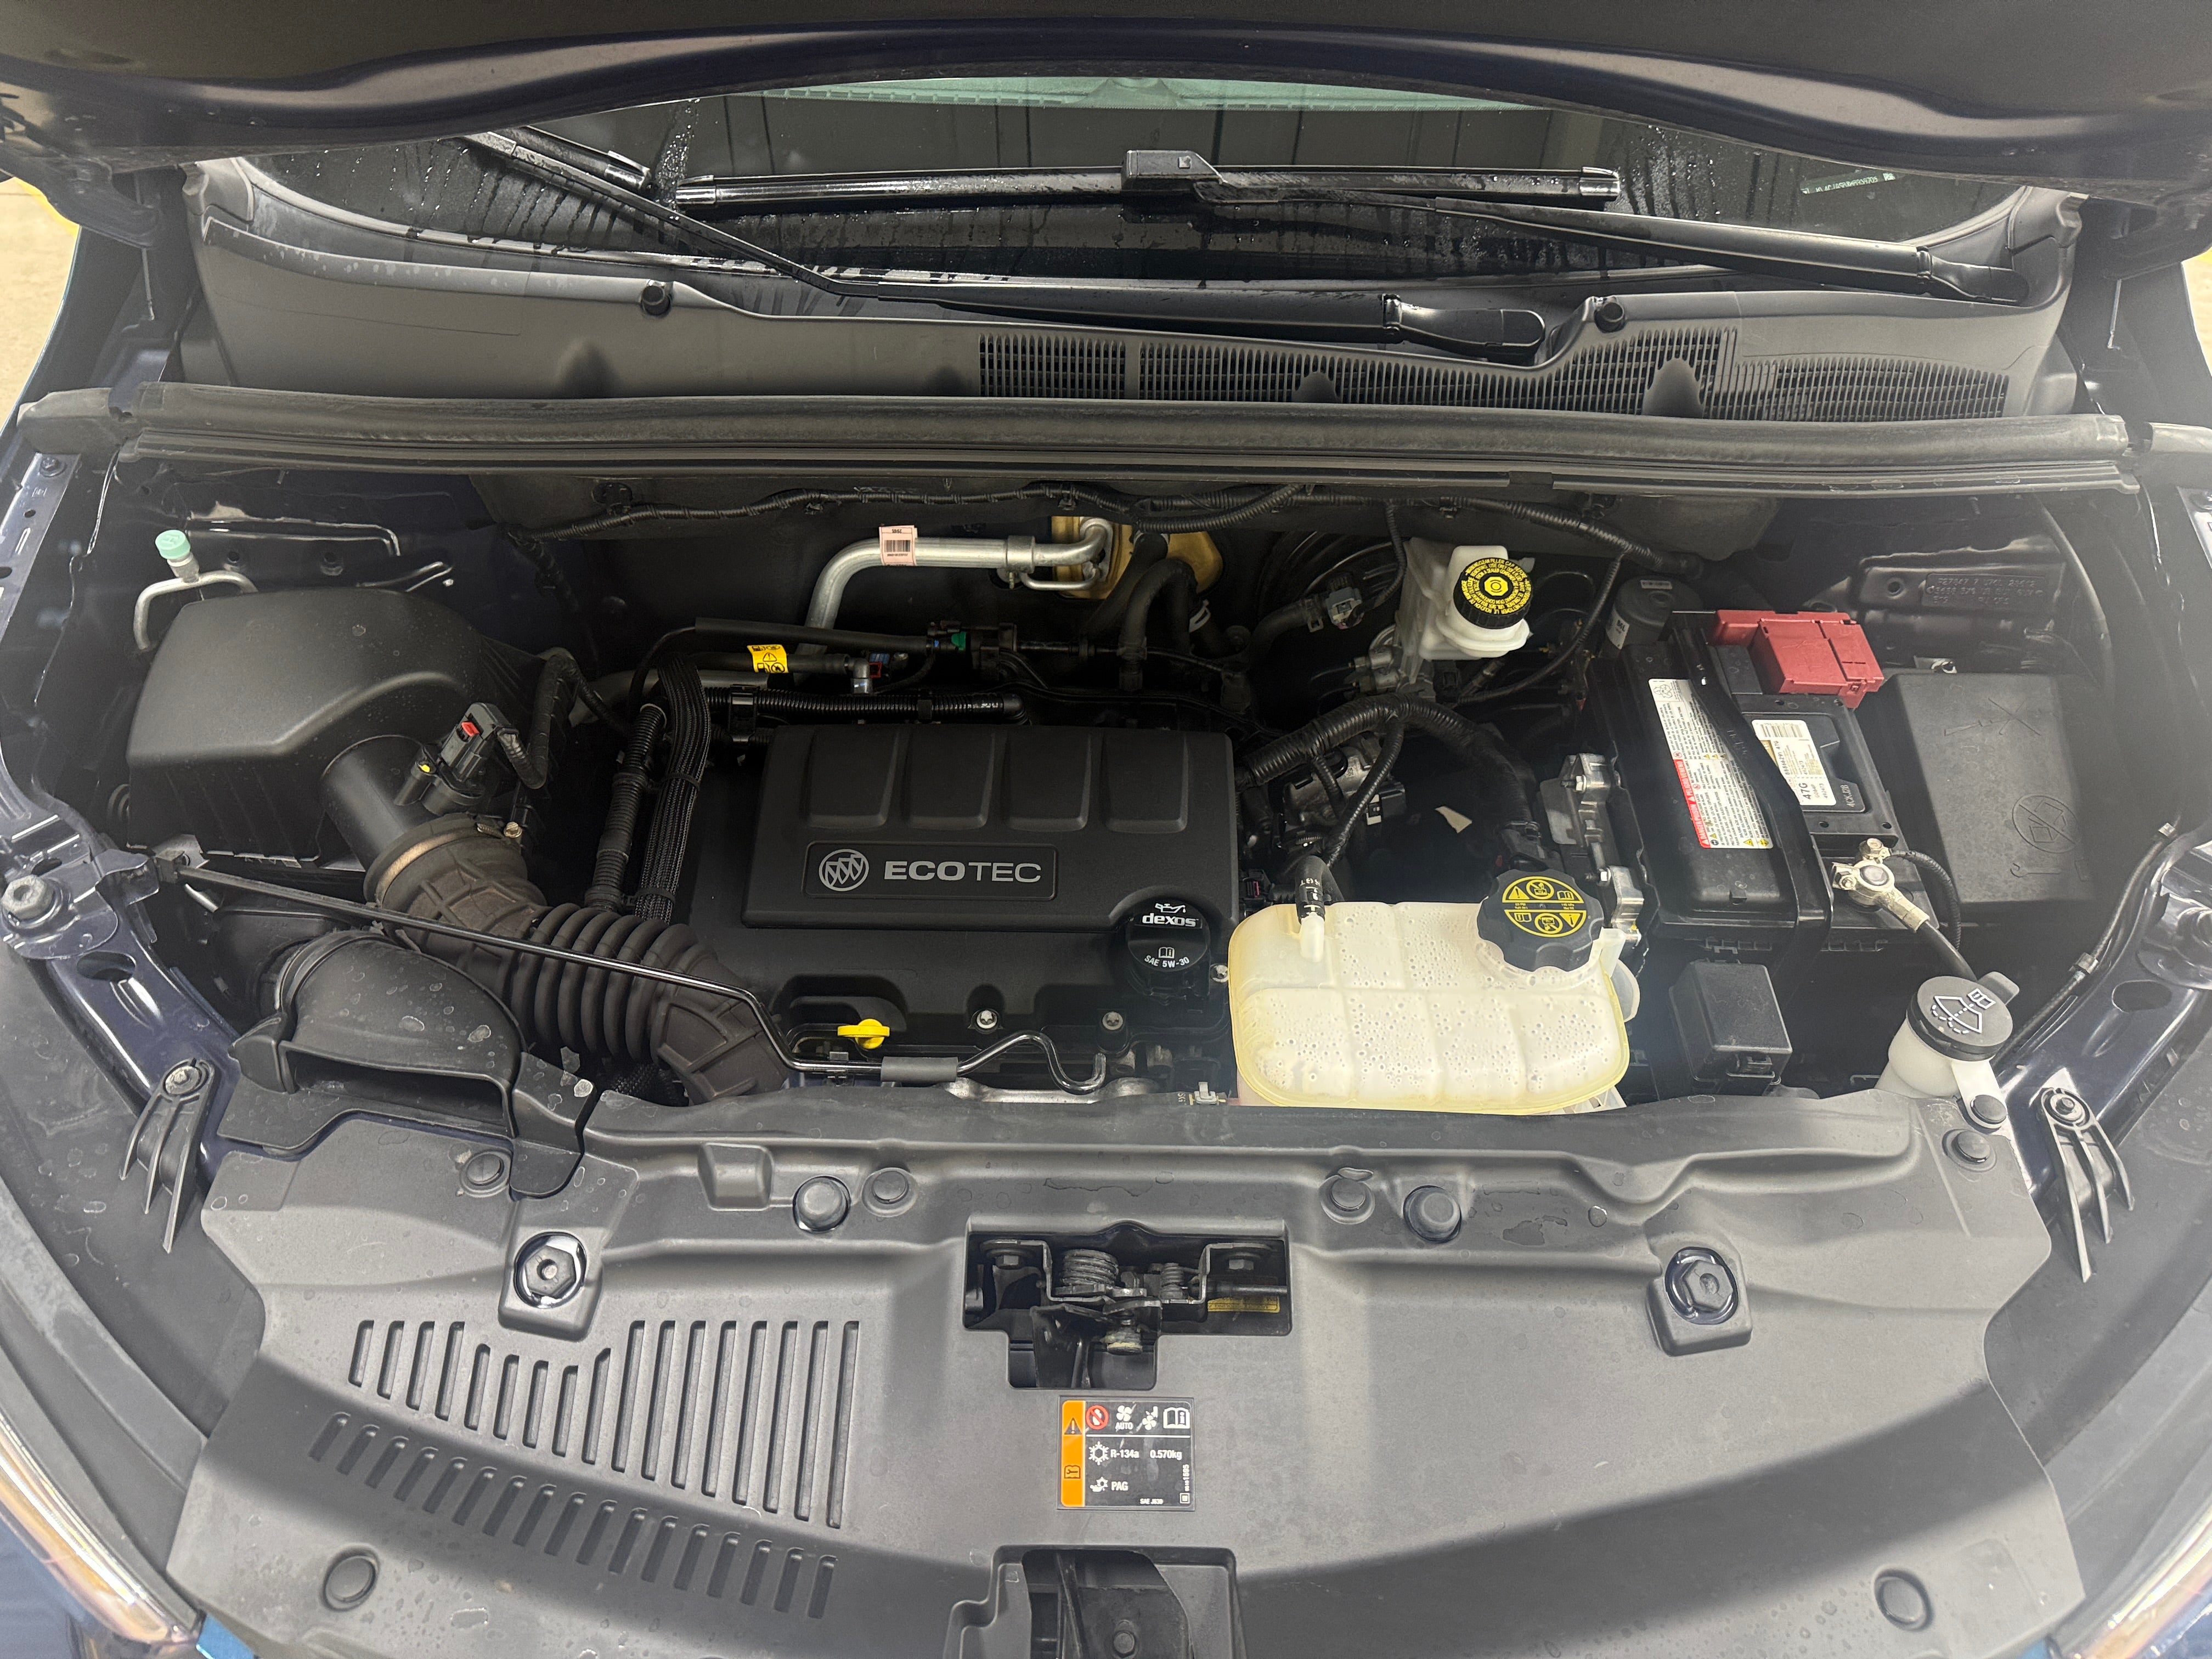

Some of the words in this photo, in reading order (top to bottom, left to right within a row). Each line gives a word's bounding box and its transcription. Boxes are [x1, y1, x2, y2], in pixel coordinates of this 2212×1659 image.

[1798, 782, 1812, 799] 47G
[884, 861, 1041, 883] ECOTEC
[1142, 913, 1197, 927] dexos
[1144, 955, 1160, 967] SAE
[1163, 957, 1189, 968] 5W-30
[1110, 1449, 1139, 1458] R-134a
[1150, 1449, 1182, 1460] 0.570kg
[1111, 1481, 1128, 1491] PAG
